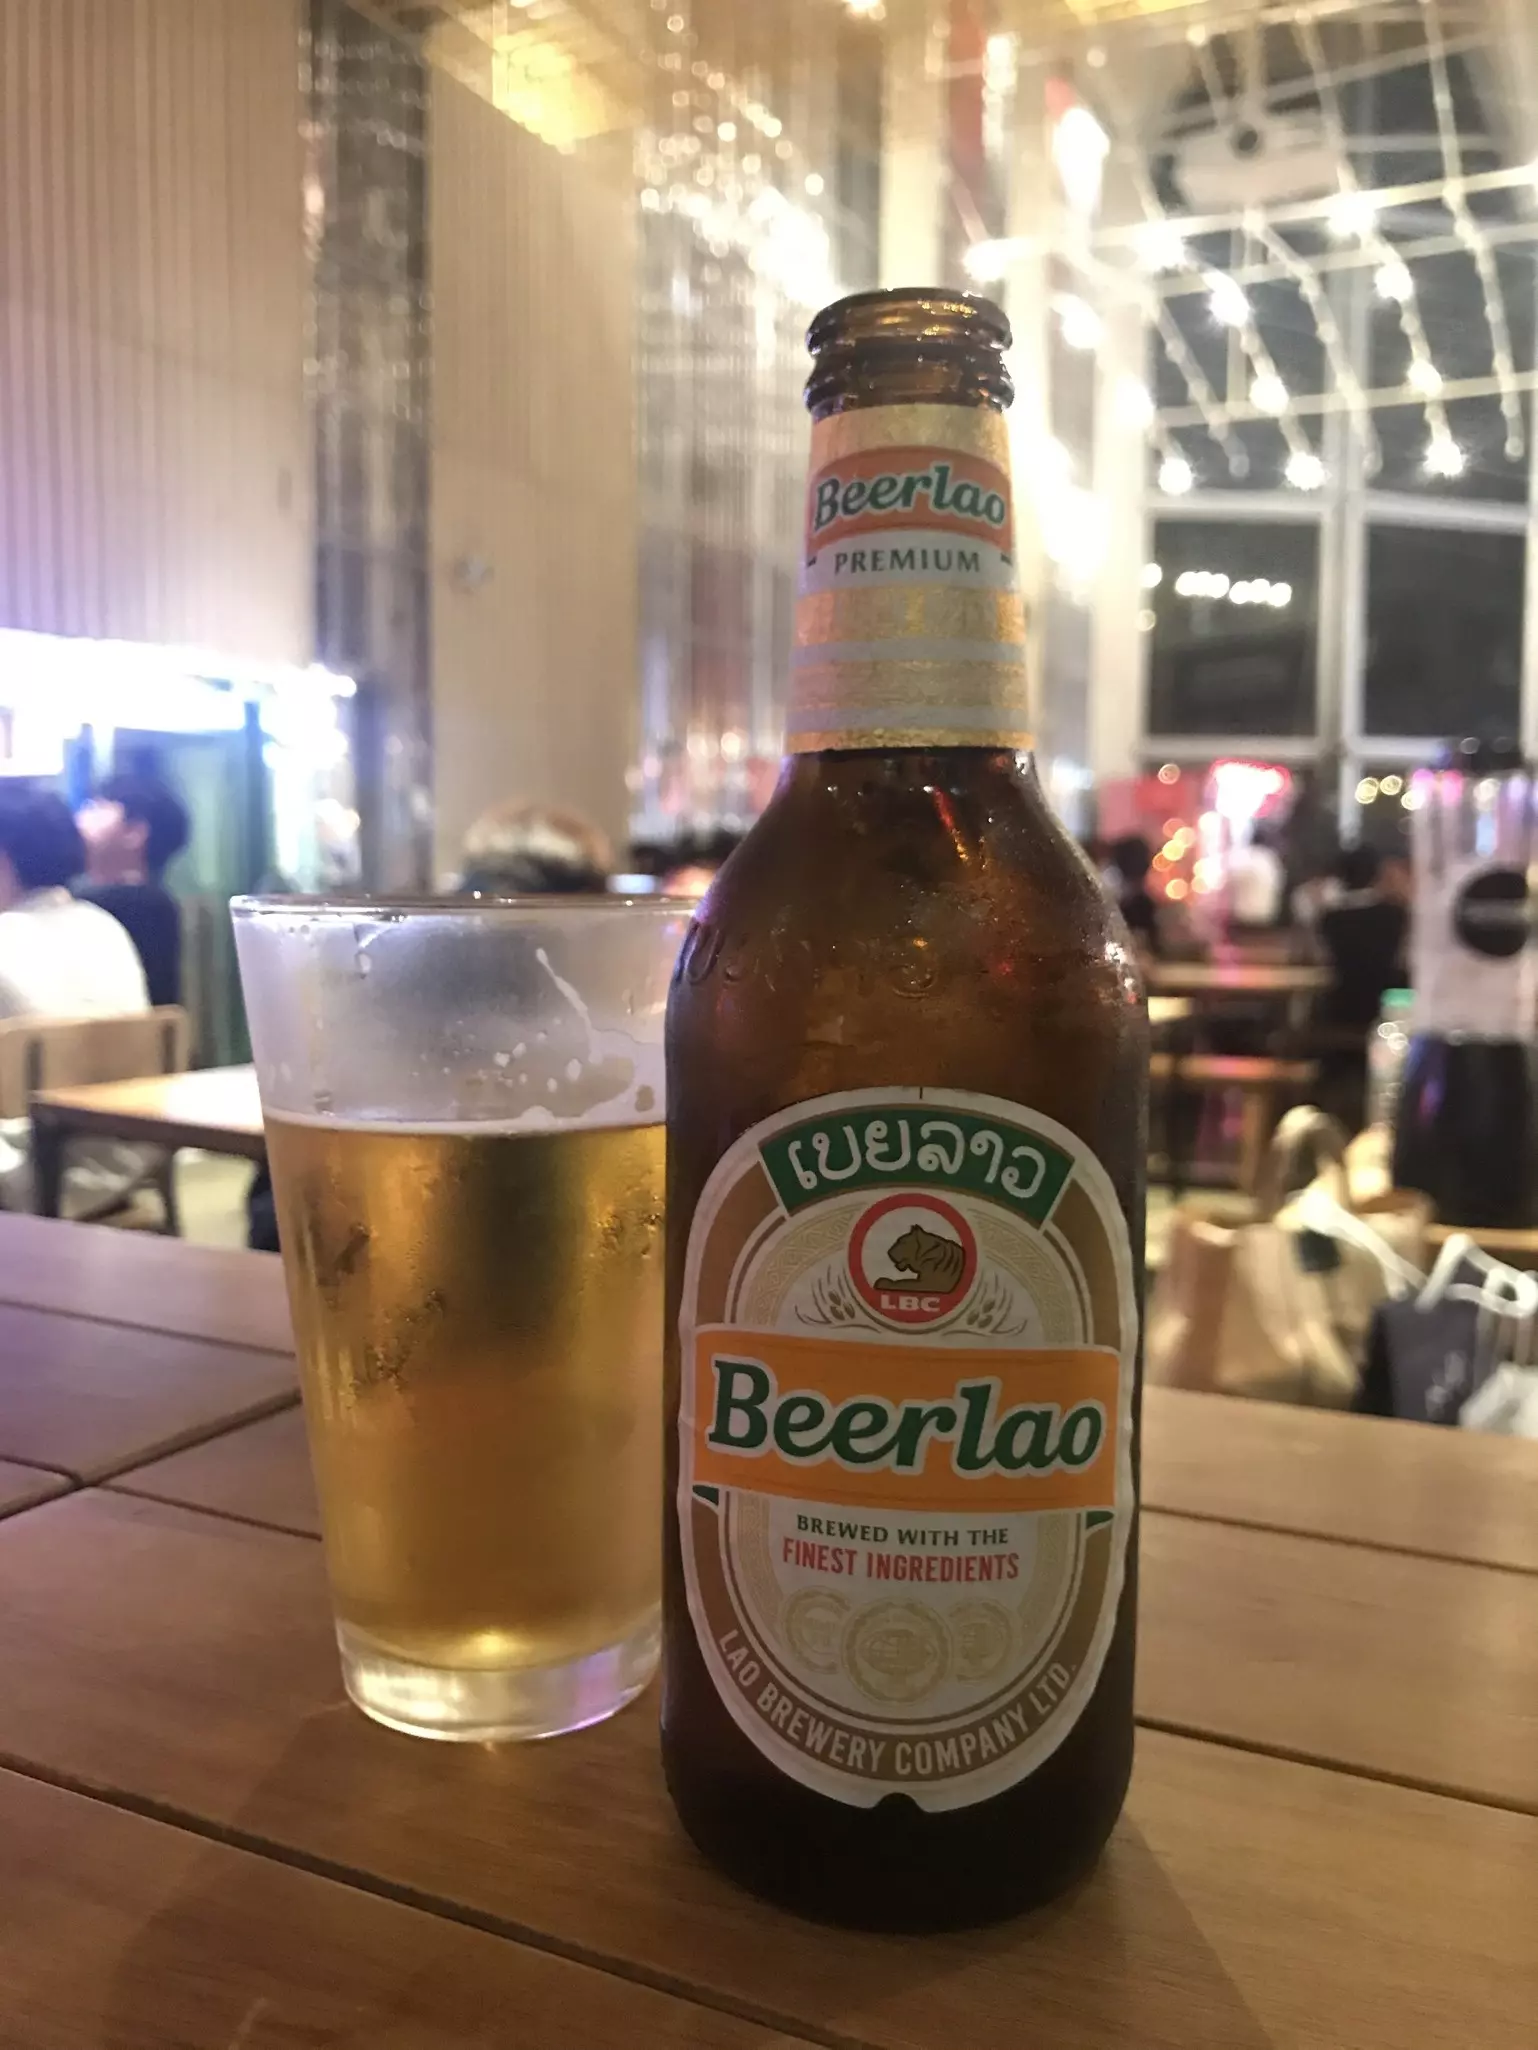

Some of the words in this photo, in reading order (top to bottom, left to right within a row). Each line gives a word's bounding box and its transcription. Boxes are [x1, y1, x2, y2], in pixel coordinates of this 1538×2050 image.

[813, 465, 1006, 532] Beerlao
[834, 549, 980, 574] PREMIUM
[788, 1119, 1047, 1199] ເບຍລາວ
[880, 1293, 941, 1313] LBC
[708, 1359, 1102, 1471] Beerlao
[796, 1514, 889, 1544] BREWED
[897, 1528, 960, 1546] WITH
[967, 1527, 1009, 1545] THE
[782, 1537, 858, 1576] FINEST
[866, 1551, 1020, 1583] INGREDIENTS
[718, 1629, 760, 1688] LAO
[756, 1682, 885, 1774] BREWERY
[894, 1708, 1028, 1777] COMPANY
